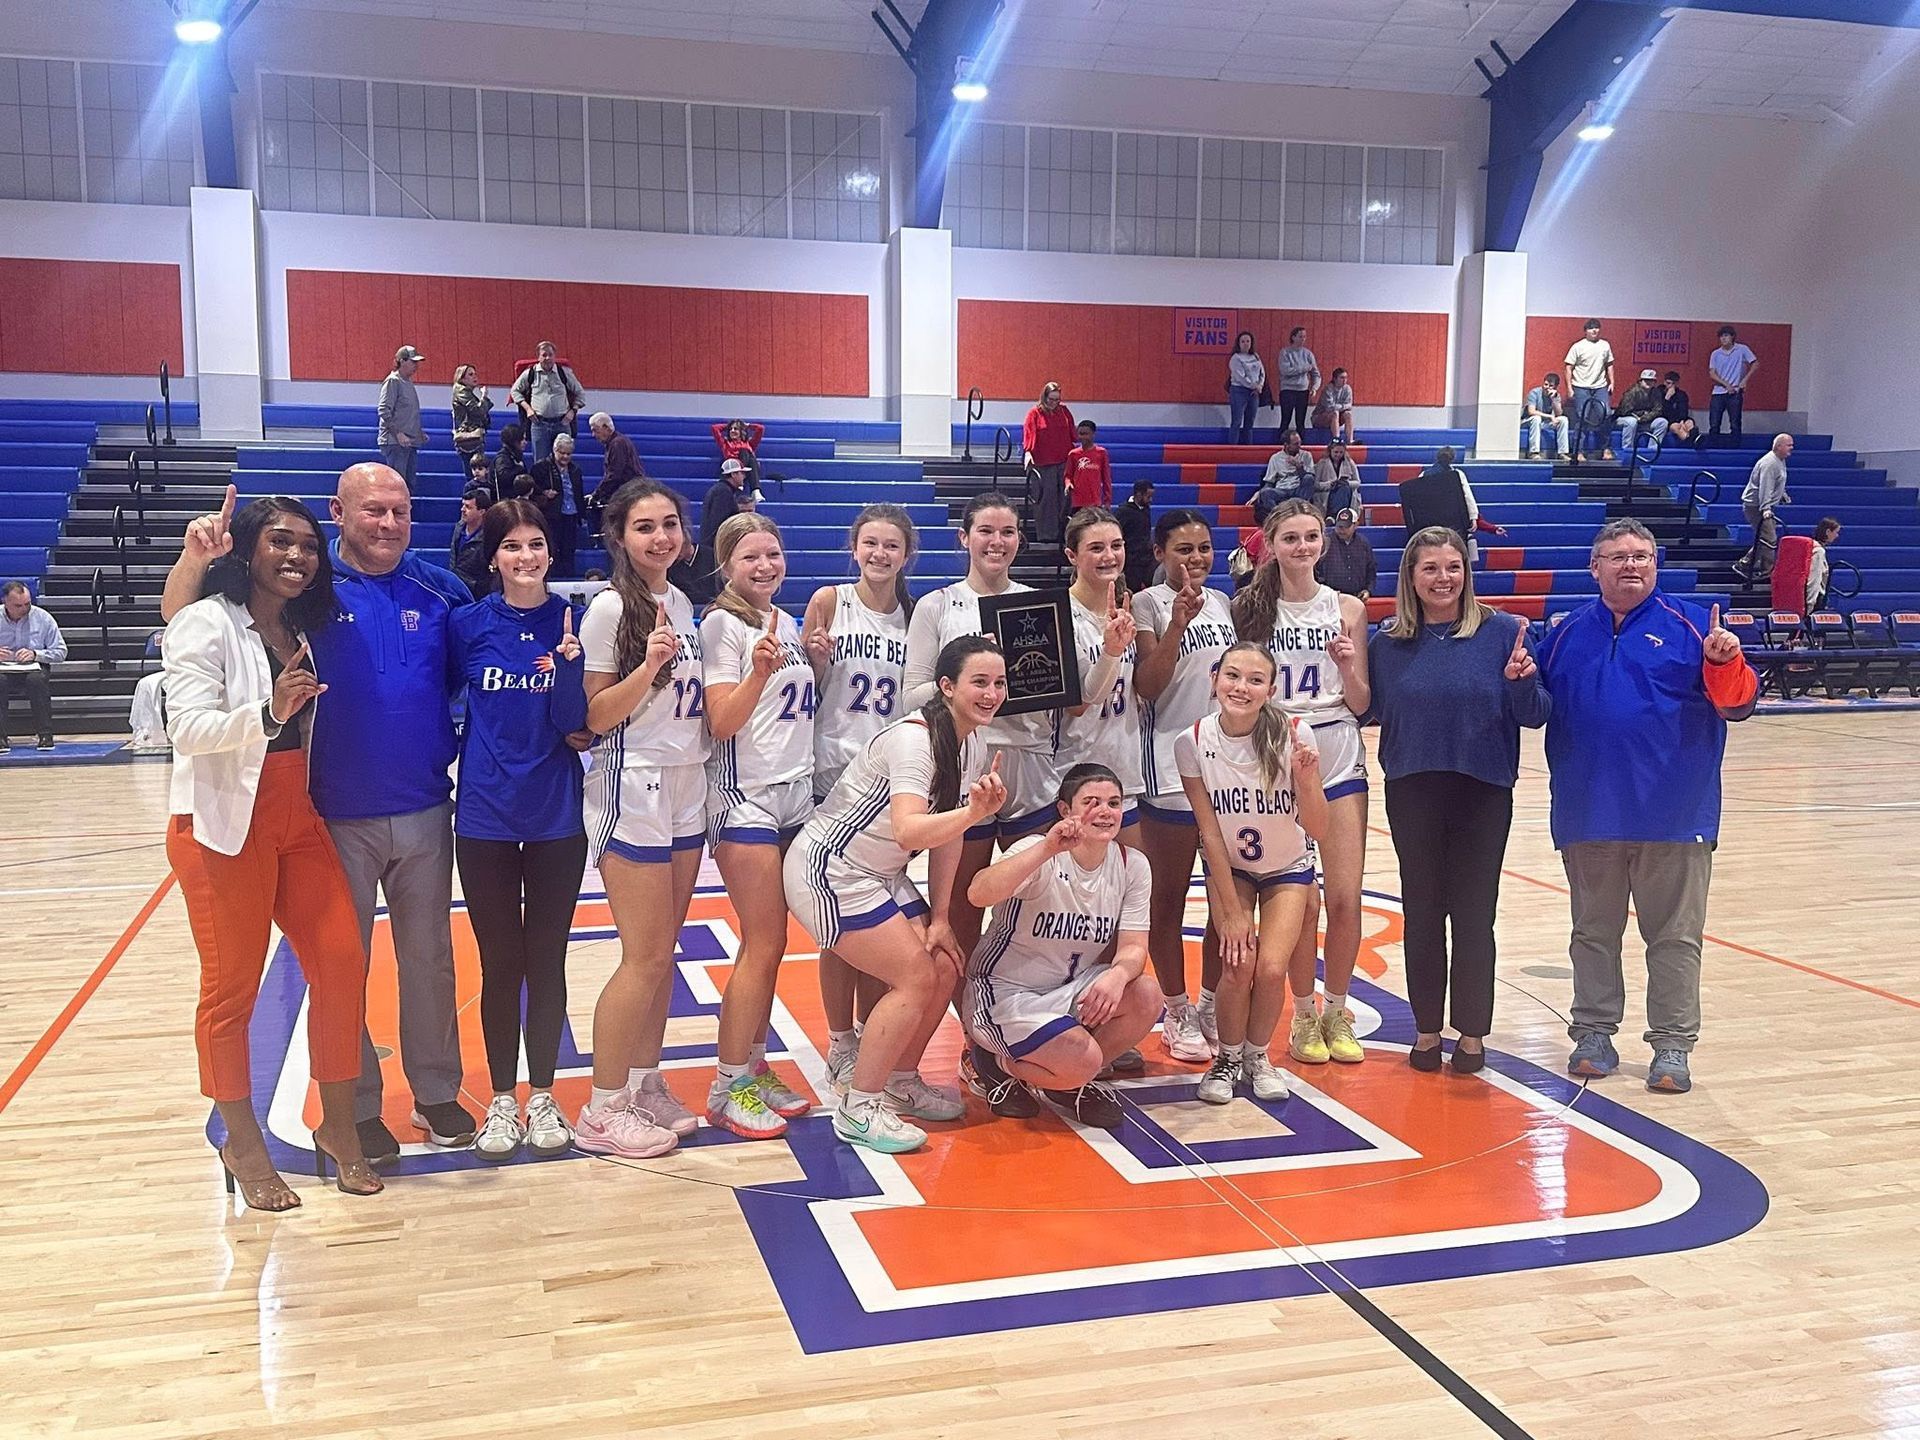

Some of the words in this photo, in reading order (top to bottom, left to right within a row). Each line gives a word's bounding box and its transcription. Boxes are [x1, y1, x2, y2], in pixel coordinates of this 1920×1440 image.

[1185, 317, 1228, 329] VISITOR
[1185, 330, 1228, 346] FANS
[1644, 329, 1681, 340] VISITOR
[1637, 342, 1687, 354] STUDENTS
[1013, 633, 1049, 647] AHSAA
[1176, 623, 1219, 662] RANGE
[481, 666, 556, 691] BEACH
[1279, 663, 1321, 701] 14
[672, 675, 703, 720] 12
[776, 679, 816, 722] 24
[847, 671, 897, 718] 23
[1208, 787, 1250, 815] ANGE
[1236, 826, 1264, 863] 3
[1032, 911, 1090, 941] ORANGE
[1062, 951, 1083, 985] 1
